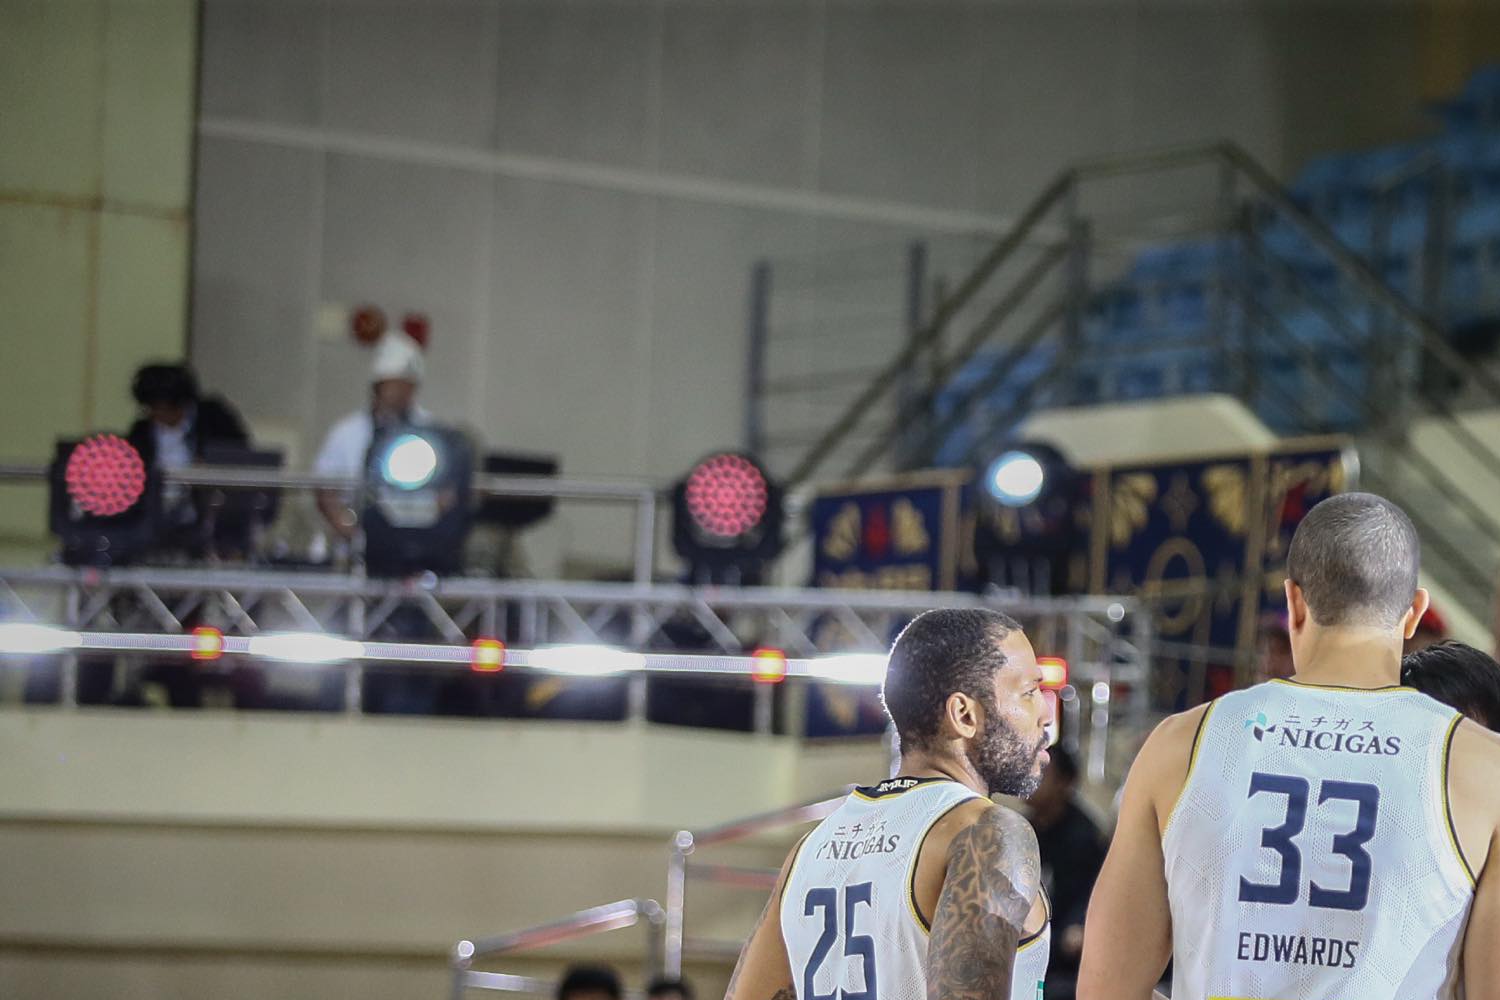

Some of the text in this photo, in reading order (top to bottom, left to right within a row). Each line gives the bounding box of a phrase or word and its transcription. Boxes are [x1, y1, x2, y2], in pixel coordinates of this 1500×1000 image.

[1285, 715, 1375, 732] ニチガス
[1279, 726, 1401, 756] NICIGAS
[1237, 771, 1380, 912] 33
[1237, 931, 1359, 970] EDWARDS
